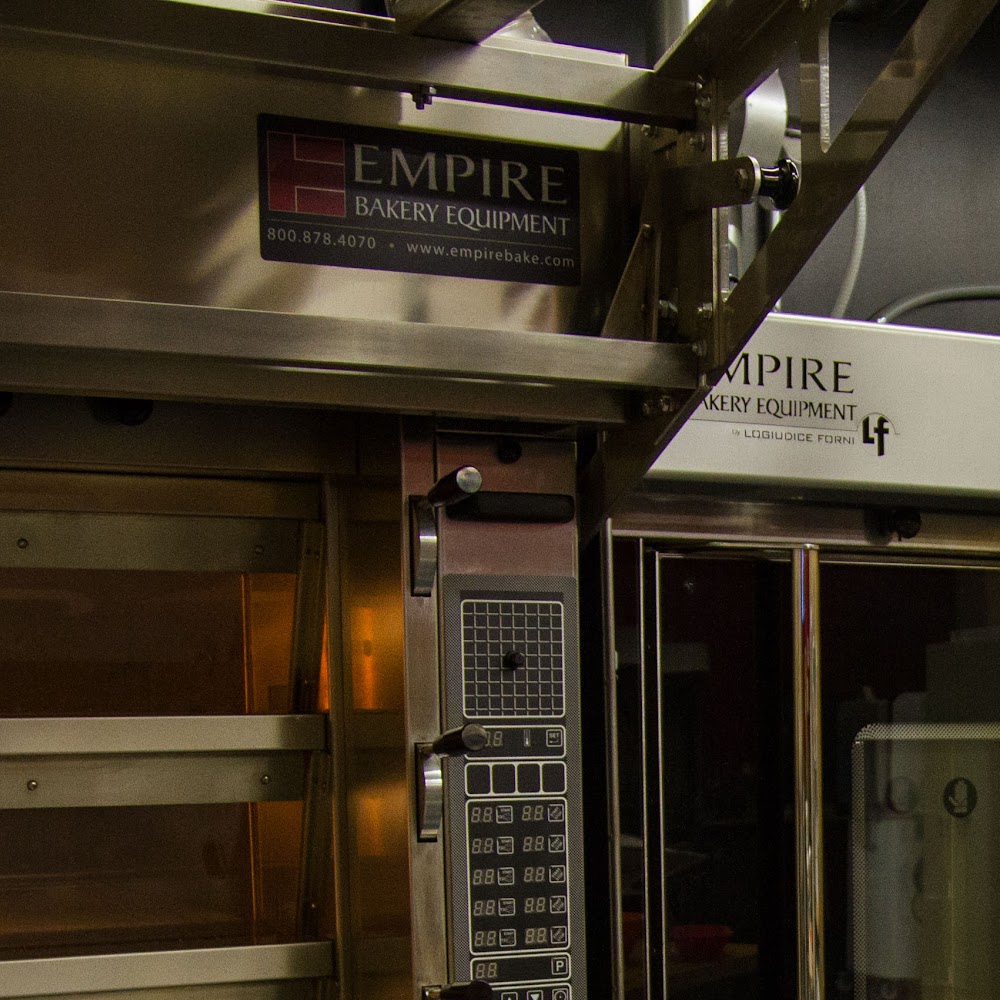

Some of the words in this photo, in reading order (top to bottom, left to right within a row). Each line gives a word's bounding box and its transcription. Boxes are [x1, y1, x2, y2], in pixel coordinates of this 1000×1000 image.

[353, 143, 567, 205] EMPIRE
[355, 196, 439, 223] BAKERY
[446, 204, 570, 236] EQUIPMENT
[267, 227, 376, 250] 800.878.4070
[406, 240, 575, 269] www.empirebake.com
[725, 352, 854, 394] MPIRE
[703, 394, 751, 413] KERY
[757, 397, 857, 421] EQUIPMENT
[744, 429, 813, 443] LOGIUDICE
[818, 434, 855, 445] FORNI
[556, 960, 564, 972] P
